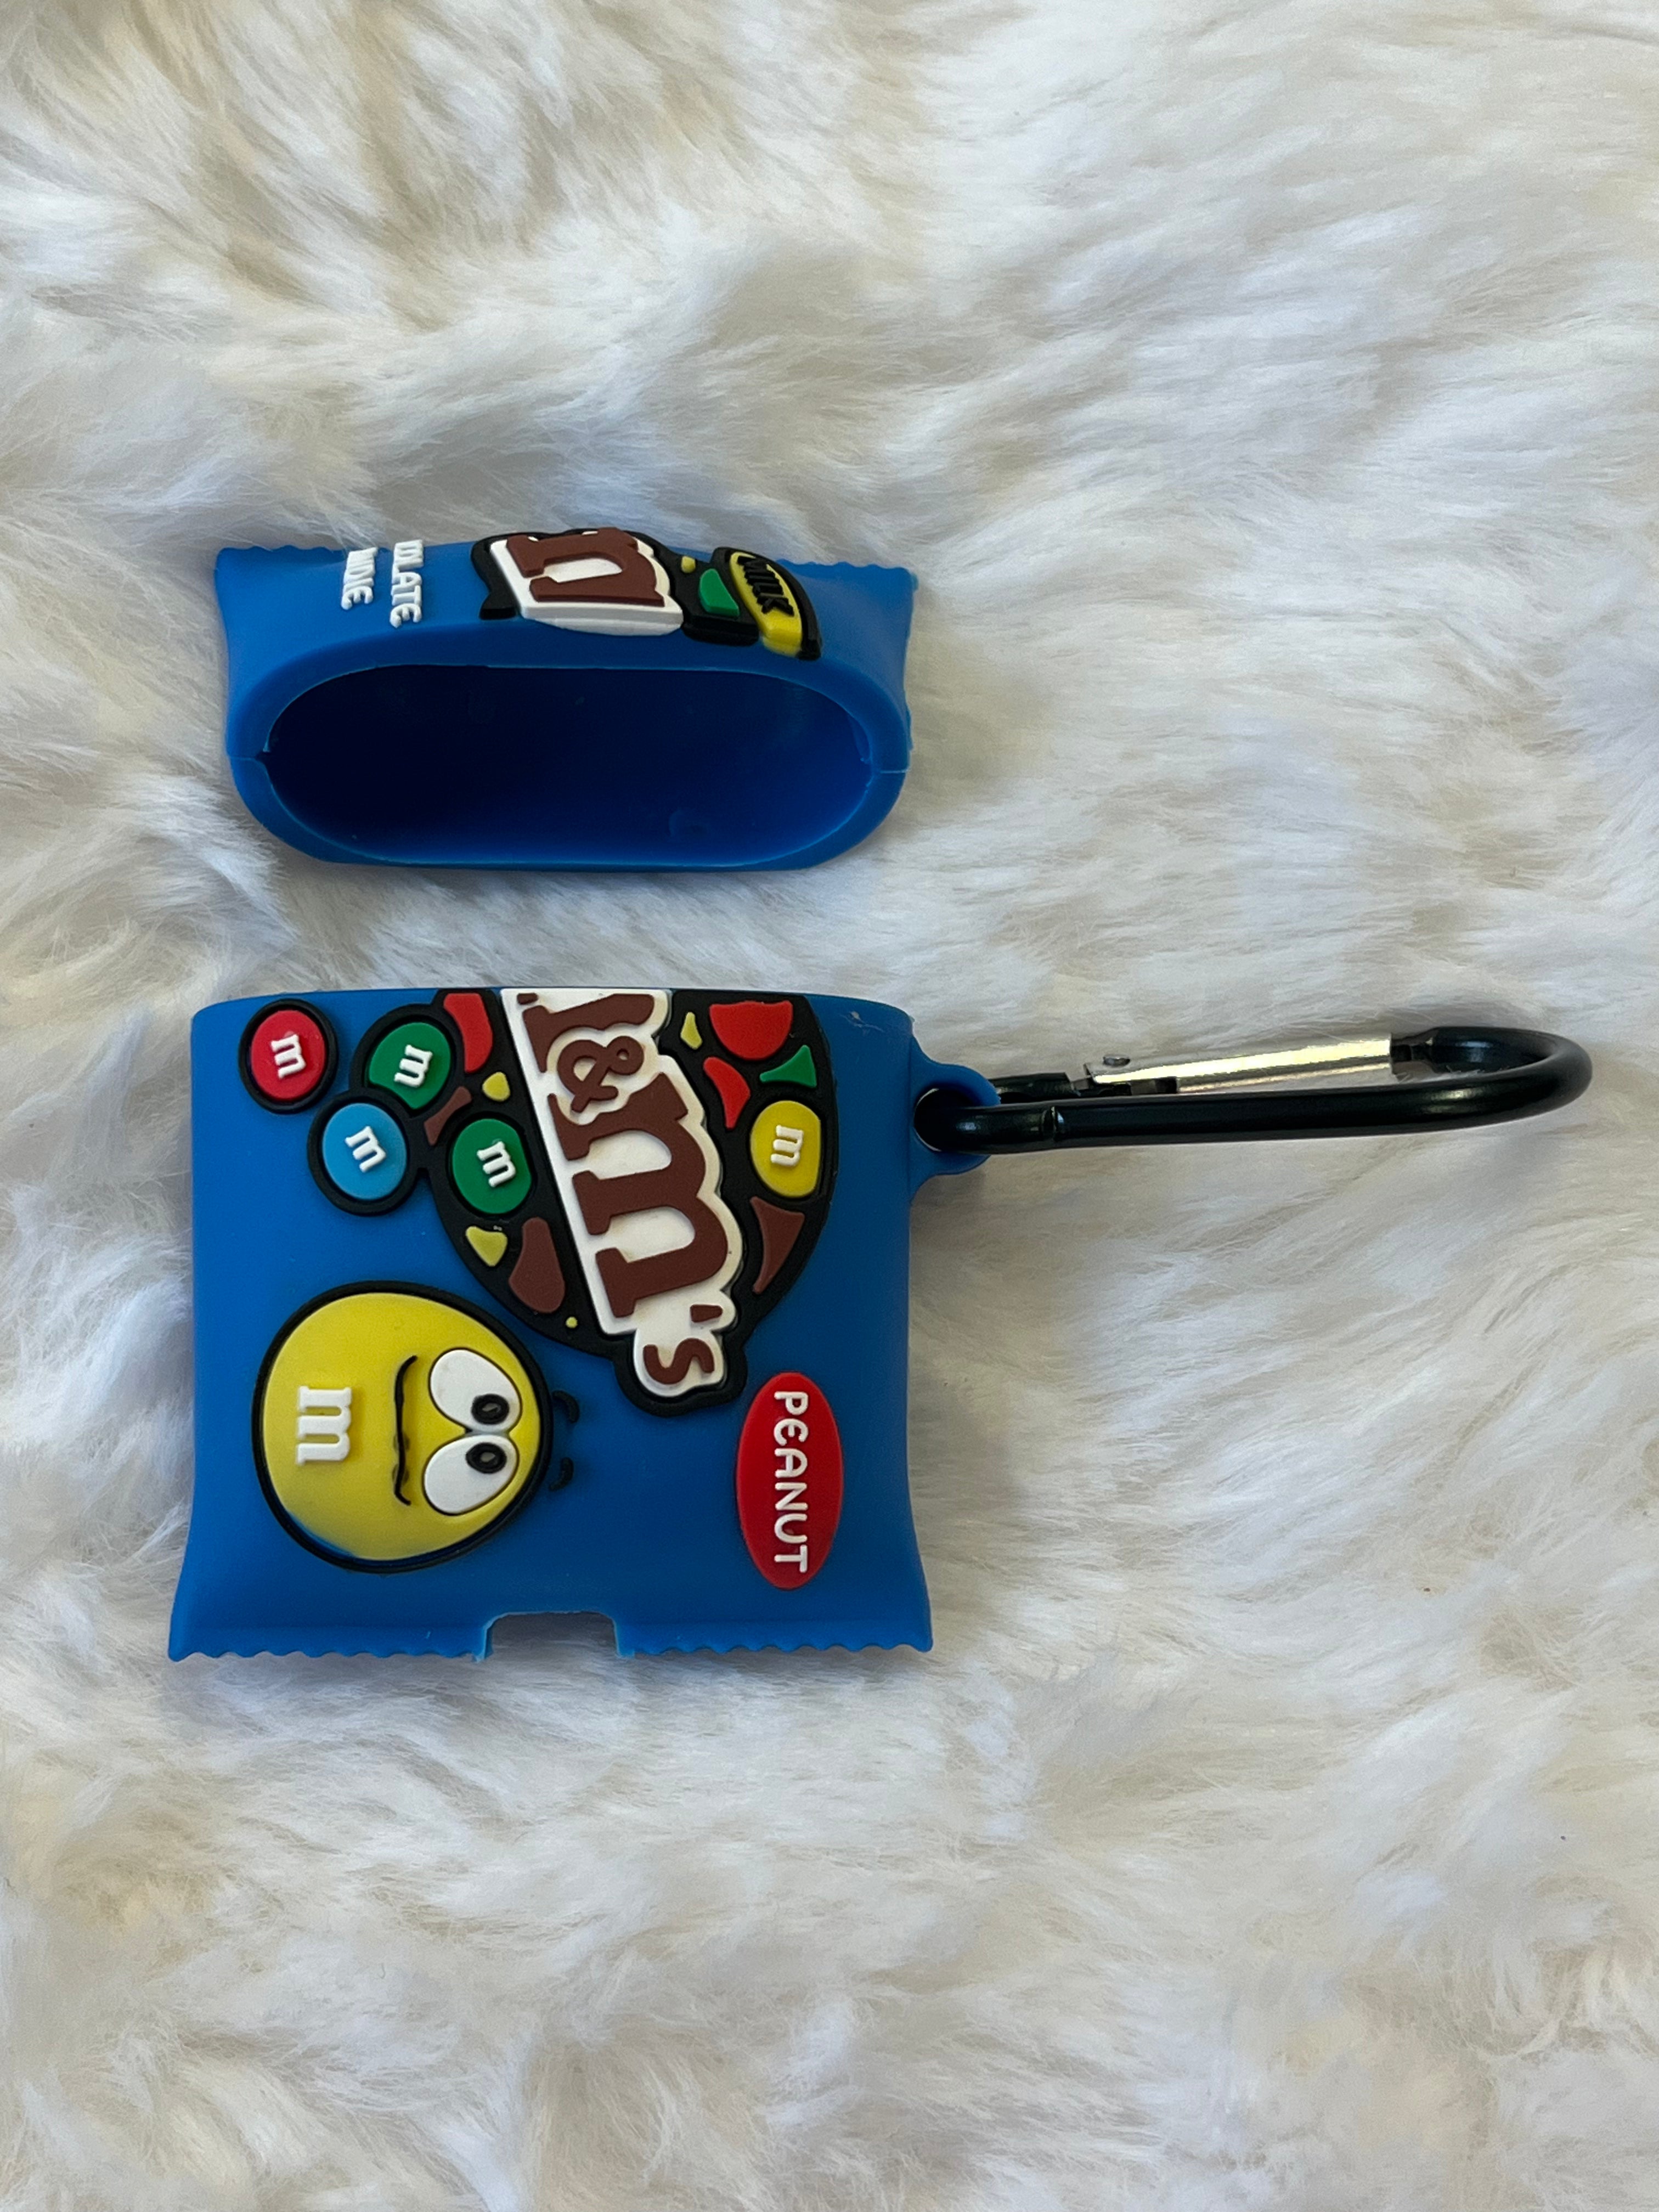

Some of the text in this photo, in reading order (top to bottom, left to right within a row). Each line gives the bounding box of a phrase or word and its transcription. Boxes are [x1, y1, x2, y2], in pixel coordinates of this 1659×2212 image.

[737, 555, 795, 617] MILK
[270, 1034, 306, 1079] m
[394, 1044, 433, 1087] m
[345, 1126, 386, 1172] m
[477, 1141, 516, 1187] m
[770, 1125, 805, 1167] m
[296, 1385, 352, 1465] m
[774, 1391, 809, 1573] PEANUT
